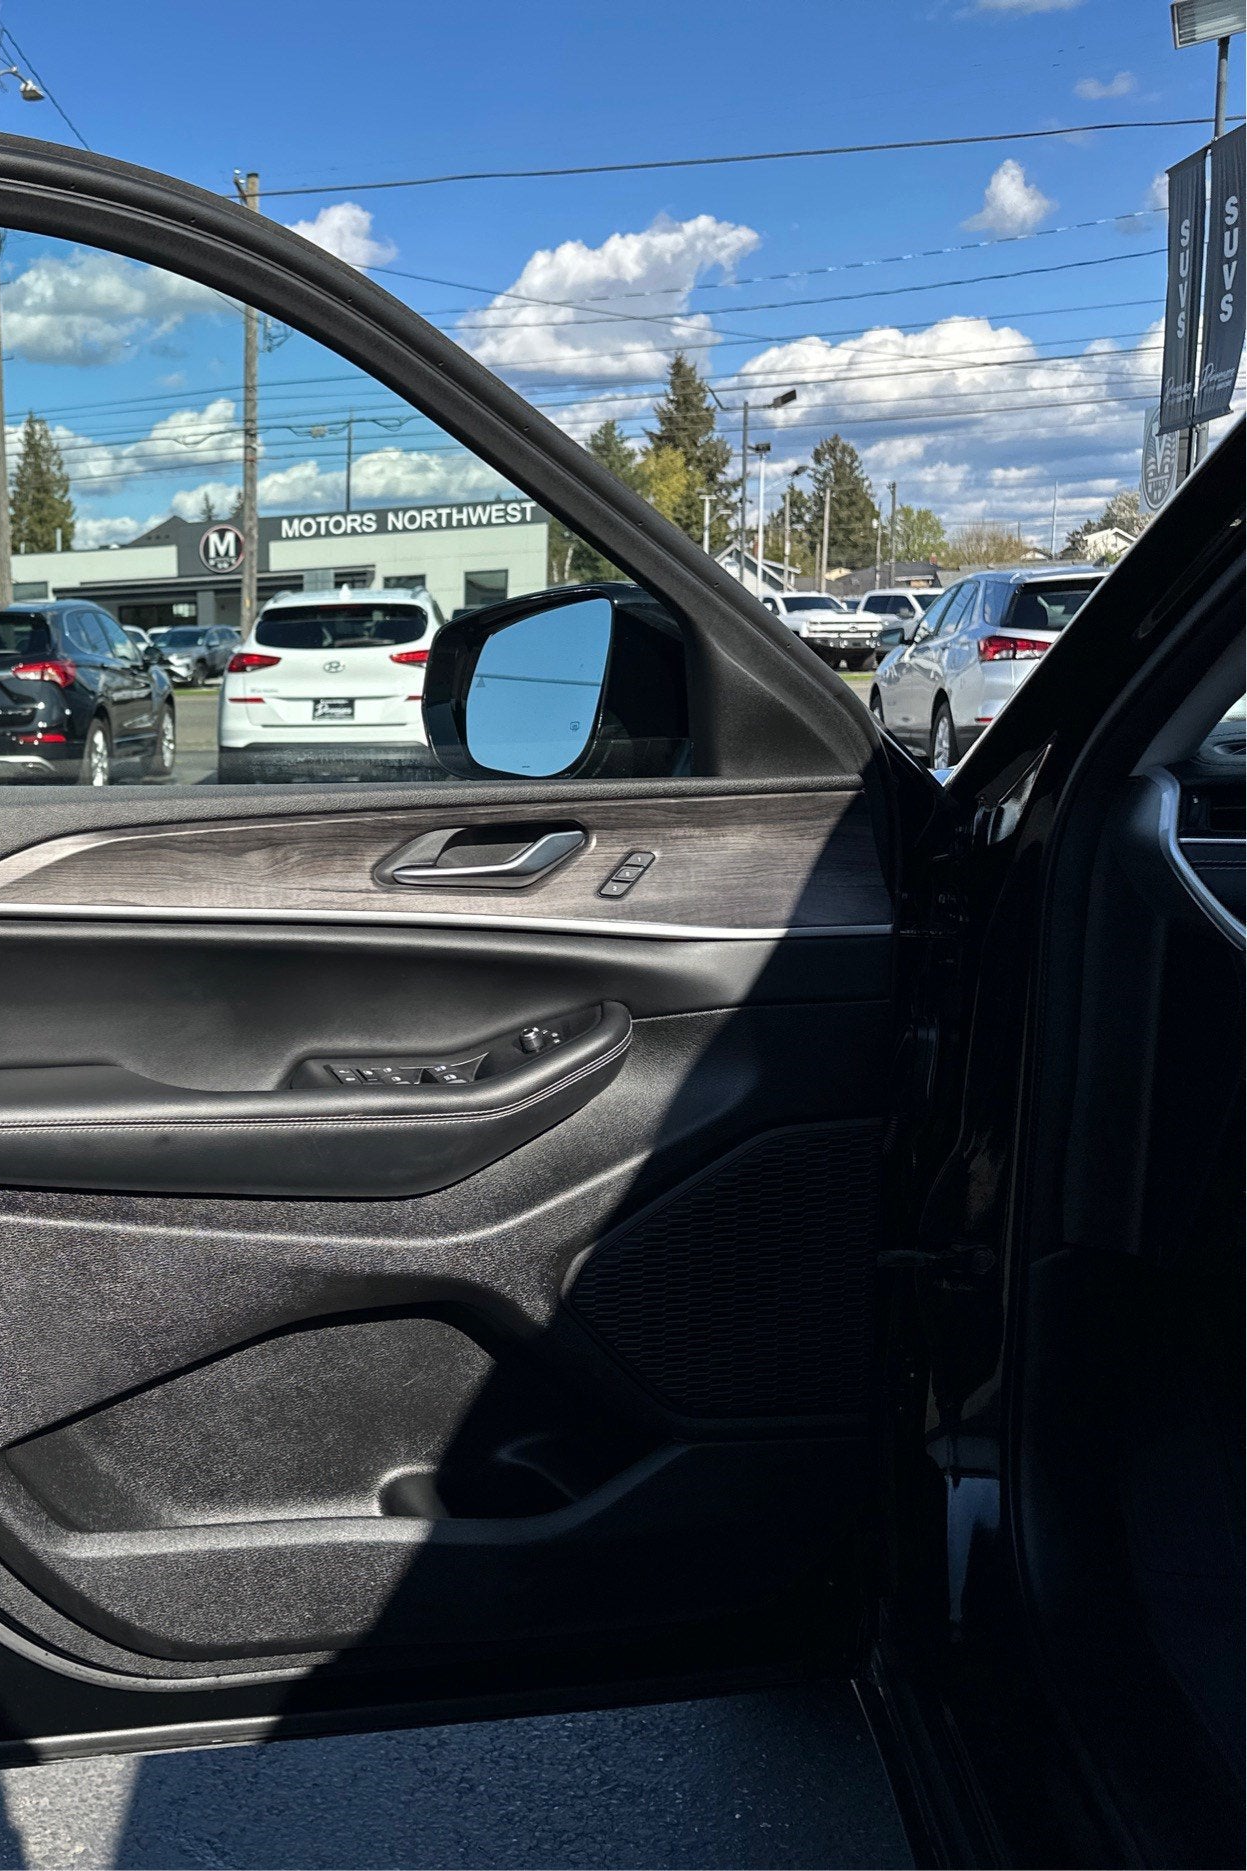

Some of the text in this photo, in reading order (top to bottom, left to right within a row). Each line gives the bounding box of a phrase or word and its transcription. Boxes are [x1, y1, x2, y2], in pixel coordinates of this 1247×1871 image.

[1176, 218, 1190, 339] SUVS
[1219, 195, 1239, 323] SUVS
[208, 531, 236, 559] M
[281, 501, 537, 539] MOTORS NORTHWEST
